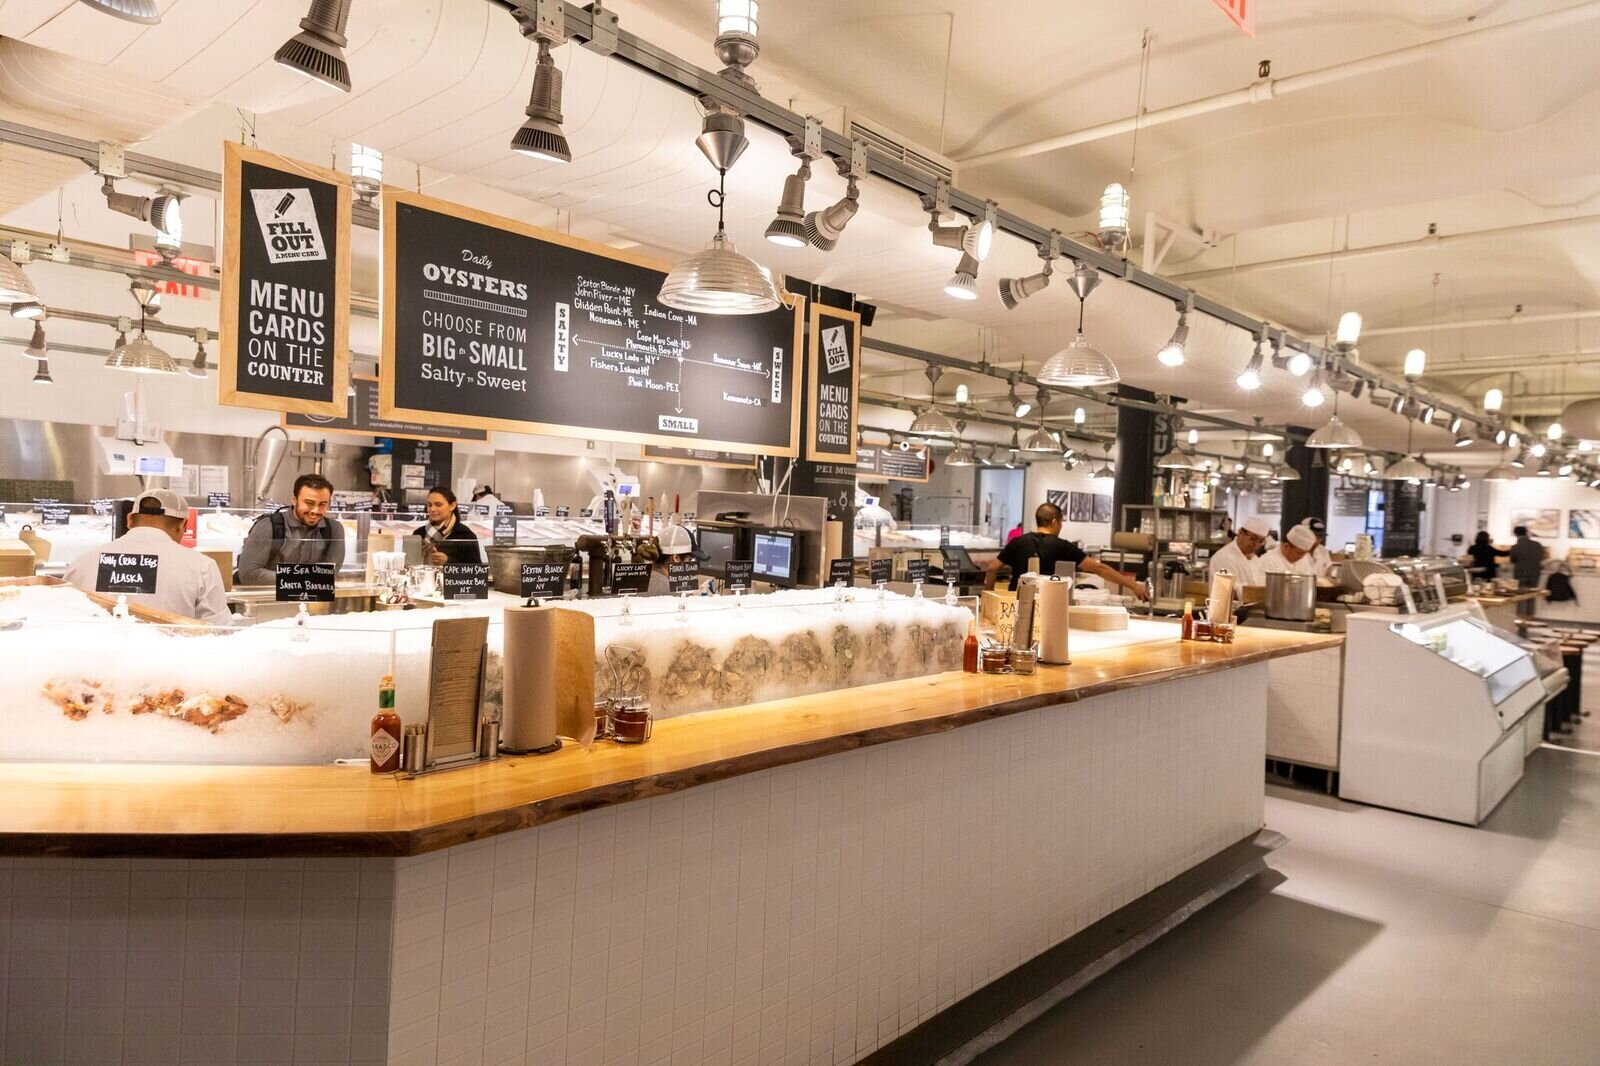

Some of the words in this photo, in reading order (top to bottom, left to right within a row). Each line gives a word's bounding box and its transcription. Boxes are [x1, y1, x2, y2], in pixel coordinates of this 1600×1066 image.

[266, 222, 312, 235] FILL
[271, 235, 315, 252] OUT
[461, 249, 493, 270] Daily
[423, 263, 528, 301] OYSTERS
[250, 279, 324, 318] MENU
[643, 304, 667, 319] Indian
[668, 311, 683, 323] Cove
[249, 310, 325, 345] CARDS
[422, 310, 482, 336] CHOOSE
[489, 322, 527, 344] FROM
[558, 308, 566, 365] SALTY
[248, 338, 277, 361] ON
[286, 343, 324, 368] THE
[422, 333, 456, 361] BIG
[469, 340, 528, 371] SMALL
[827, 346, 844, 356] FILL
[829, 354, 846, 366] OUT
[247, 361, 324, 385] COUNTER
[421, 363, 466, 387] Salty
[477, 370, 527, 392] Sweet
[820, 384, 849, 403] MENU
[820, 402, 849, 420] CARDS
[662, 419, 695, 430] SMALL
[819, 419, 830, 432] ON
[833, 420, 848, 434] THE
[818, 434, 848, 445] COUNTER
[815, 464, 833, 474] PEI
[118, 554, 137, 566] CRAB
[140, 554, 158, 568] LEGS
[276, 564, 291, 574] LIVE
[293, 564, 310, 575] SEA
[444, 565, 459, 574] CAPE
[461, 565, 474, 574] MAY
[110, 570, 143, 584] ALASKA
[280, 579, 303, 590] SANTA
[371, 742, 397, 751] ABASCO
